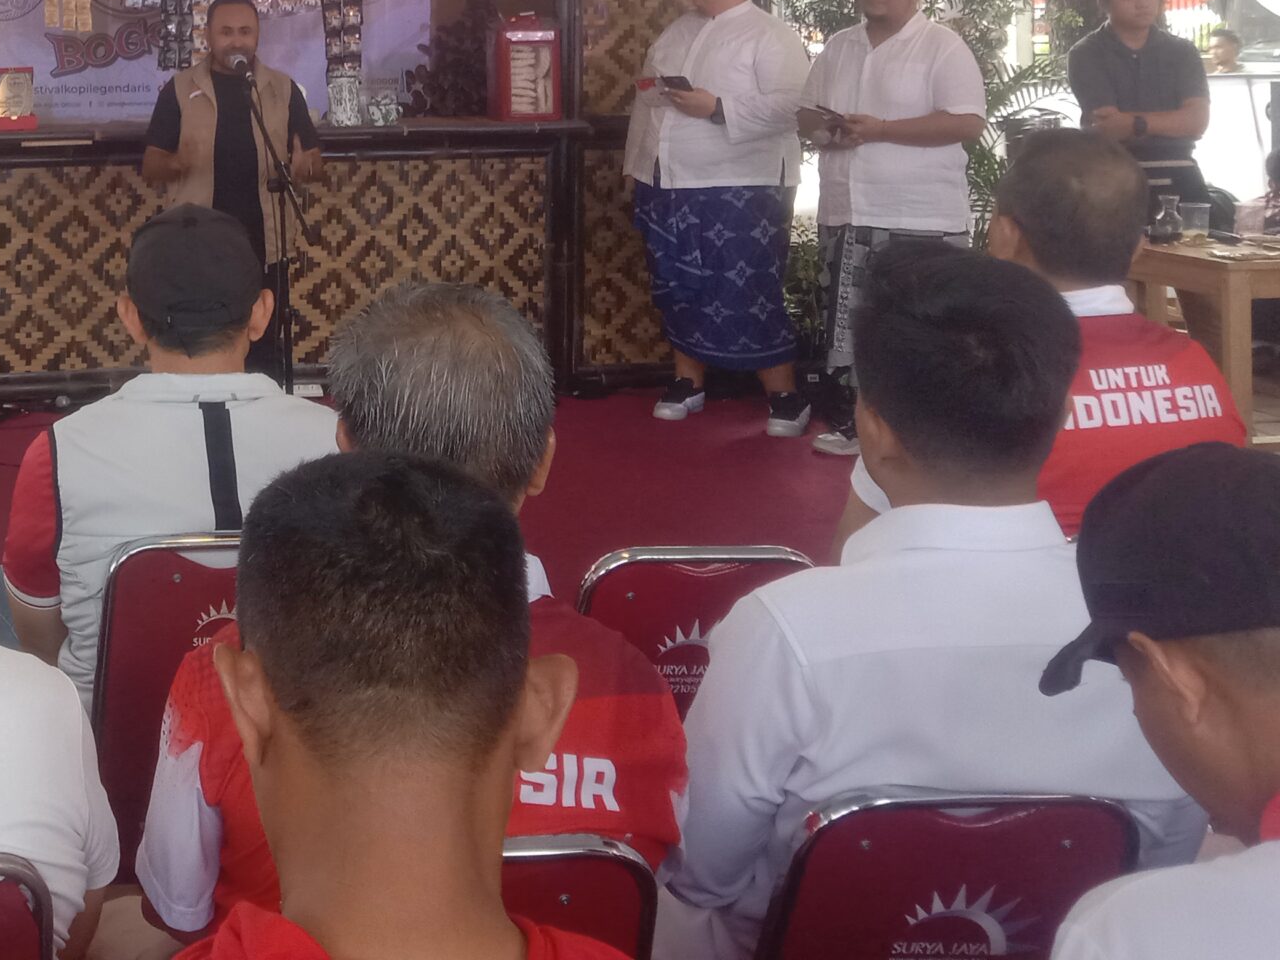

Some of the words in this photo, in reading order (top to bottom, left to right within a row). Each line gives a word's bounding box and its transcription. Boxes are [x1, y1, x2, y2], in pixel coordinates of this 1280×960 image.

[1089, 364, 1171, 390] UNTUK
[1064, 384, 1222, 430] DONESIA
[653, 665, 688, 675] URYA
[891, 942, 945, 955] SURYA
[949, 942, 989, 955] JAYA
